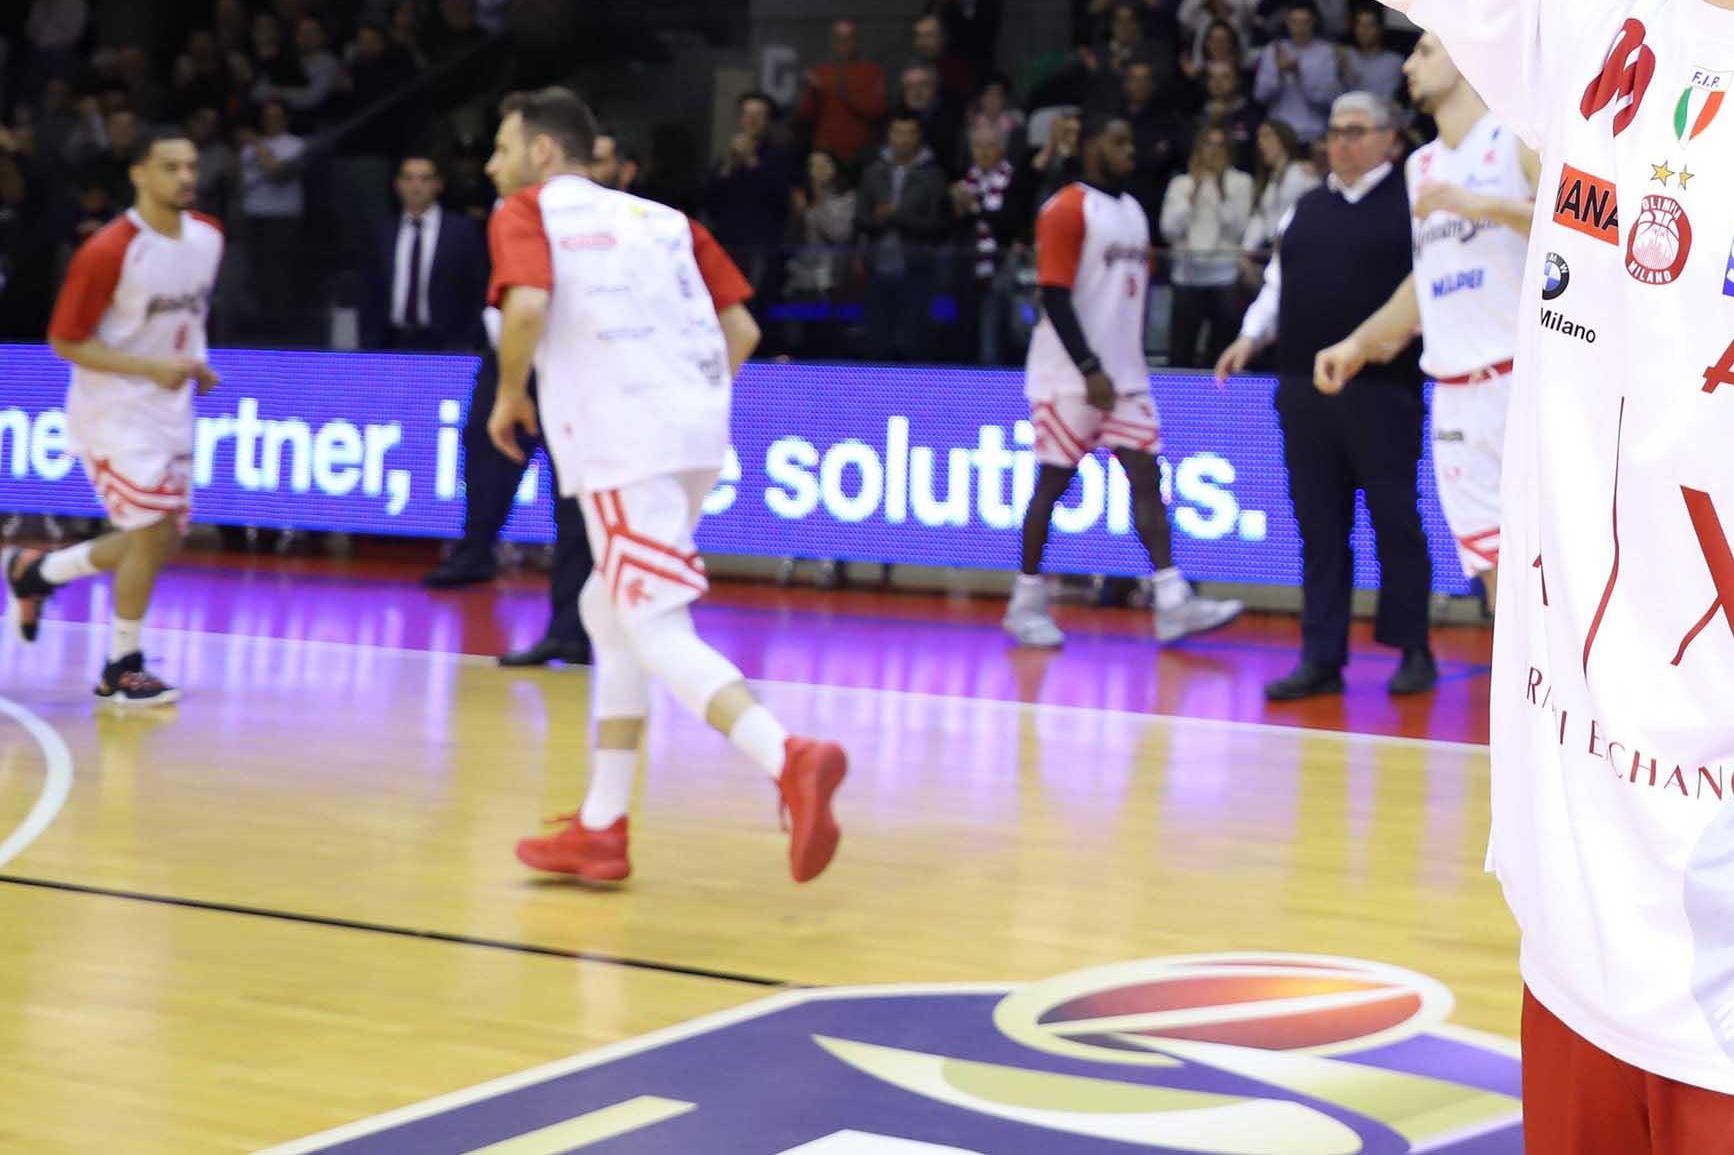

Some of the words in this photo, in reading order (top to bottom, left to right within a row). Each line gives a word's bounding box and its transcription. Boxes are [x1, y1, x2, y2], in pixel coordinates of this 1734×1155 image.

[1692, 71, 1720, 88] F.I.P.
[1556, 176, 1618, 231] ANA
[1627, 259, 1673, 285] MILANO
[1540, 307, 1597, 344] Milano
[0, 406, 75, 481] ne
[193, 397, 411, 516] rtner,
